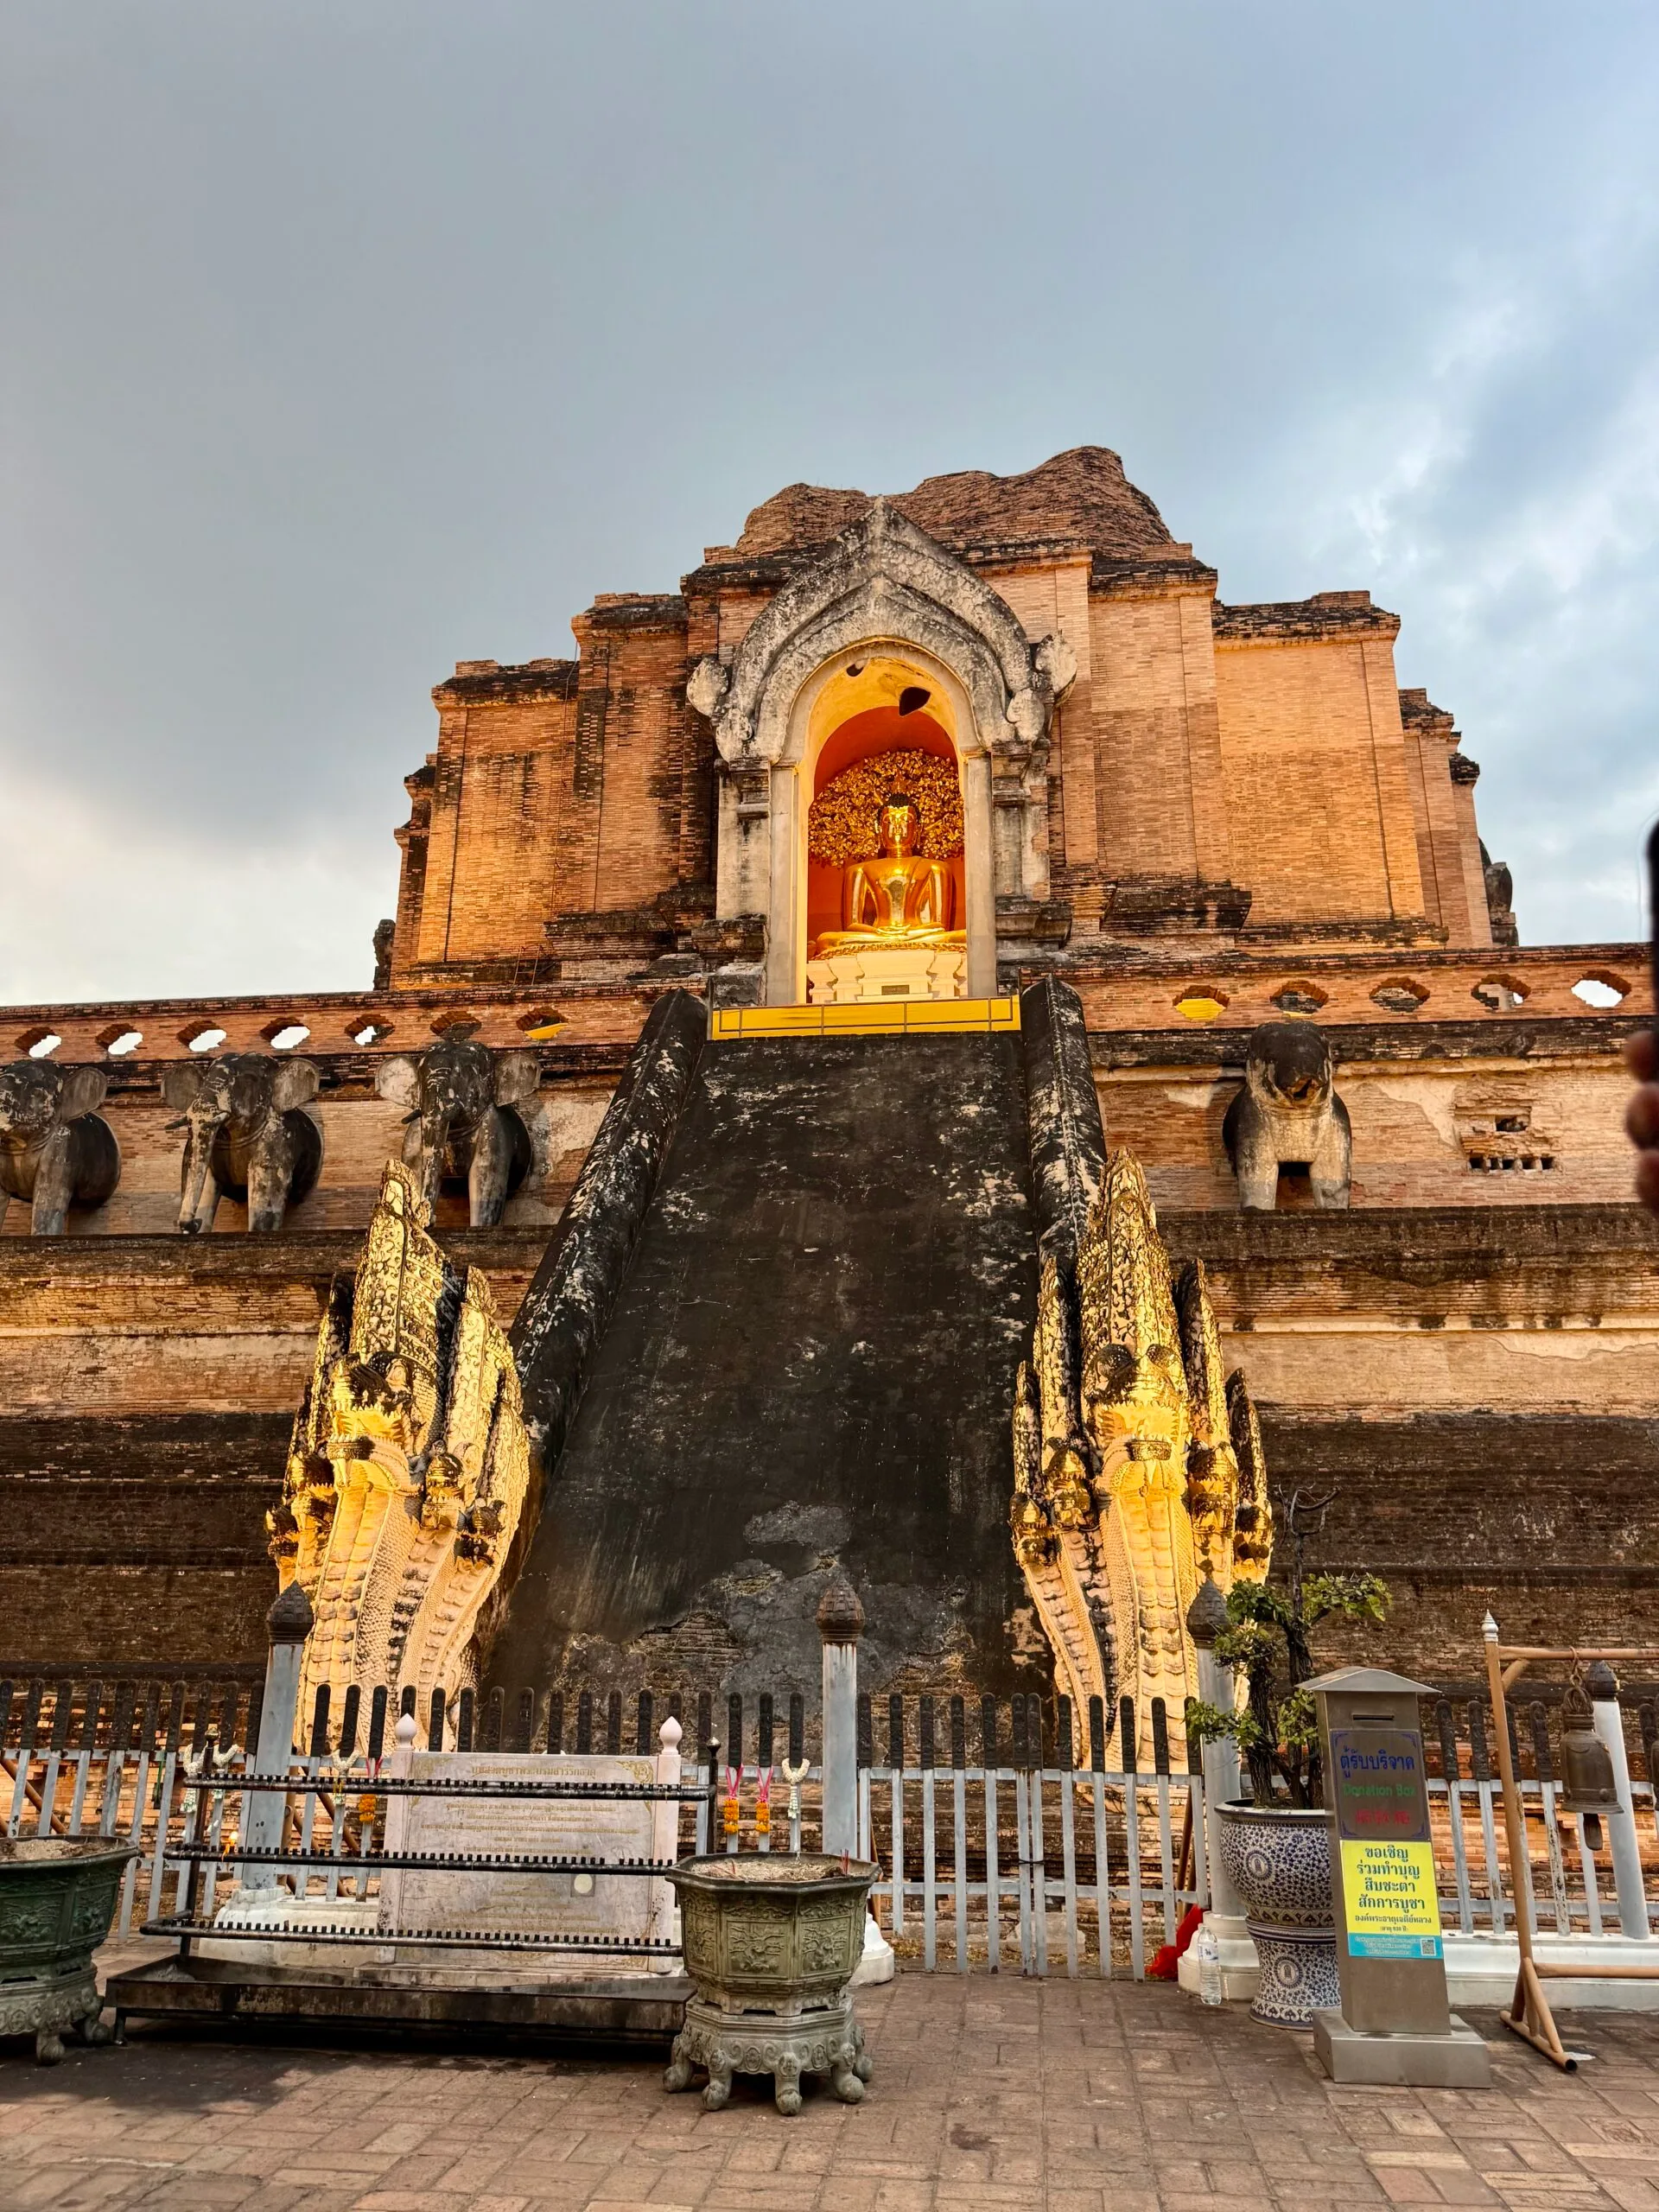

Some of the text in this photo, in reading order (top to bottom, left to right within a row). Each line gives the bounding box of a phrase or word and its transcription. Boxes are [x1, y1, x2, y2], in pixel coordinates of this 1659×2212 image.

[1340, 1746, 1414, 1778] ตู้รับบริจาค
[1344, 1783, 1415, 1796] Donation Box
[1365, 1844, 1408, 1862] ขอเชิญ
[1357, 1859, 1420, 1879] ร่วมทำบุญ
[1358, 1893, 1425, 1913] สักการบูชา
